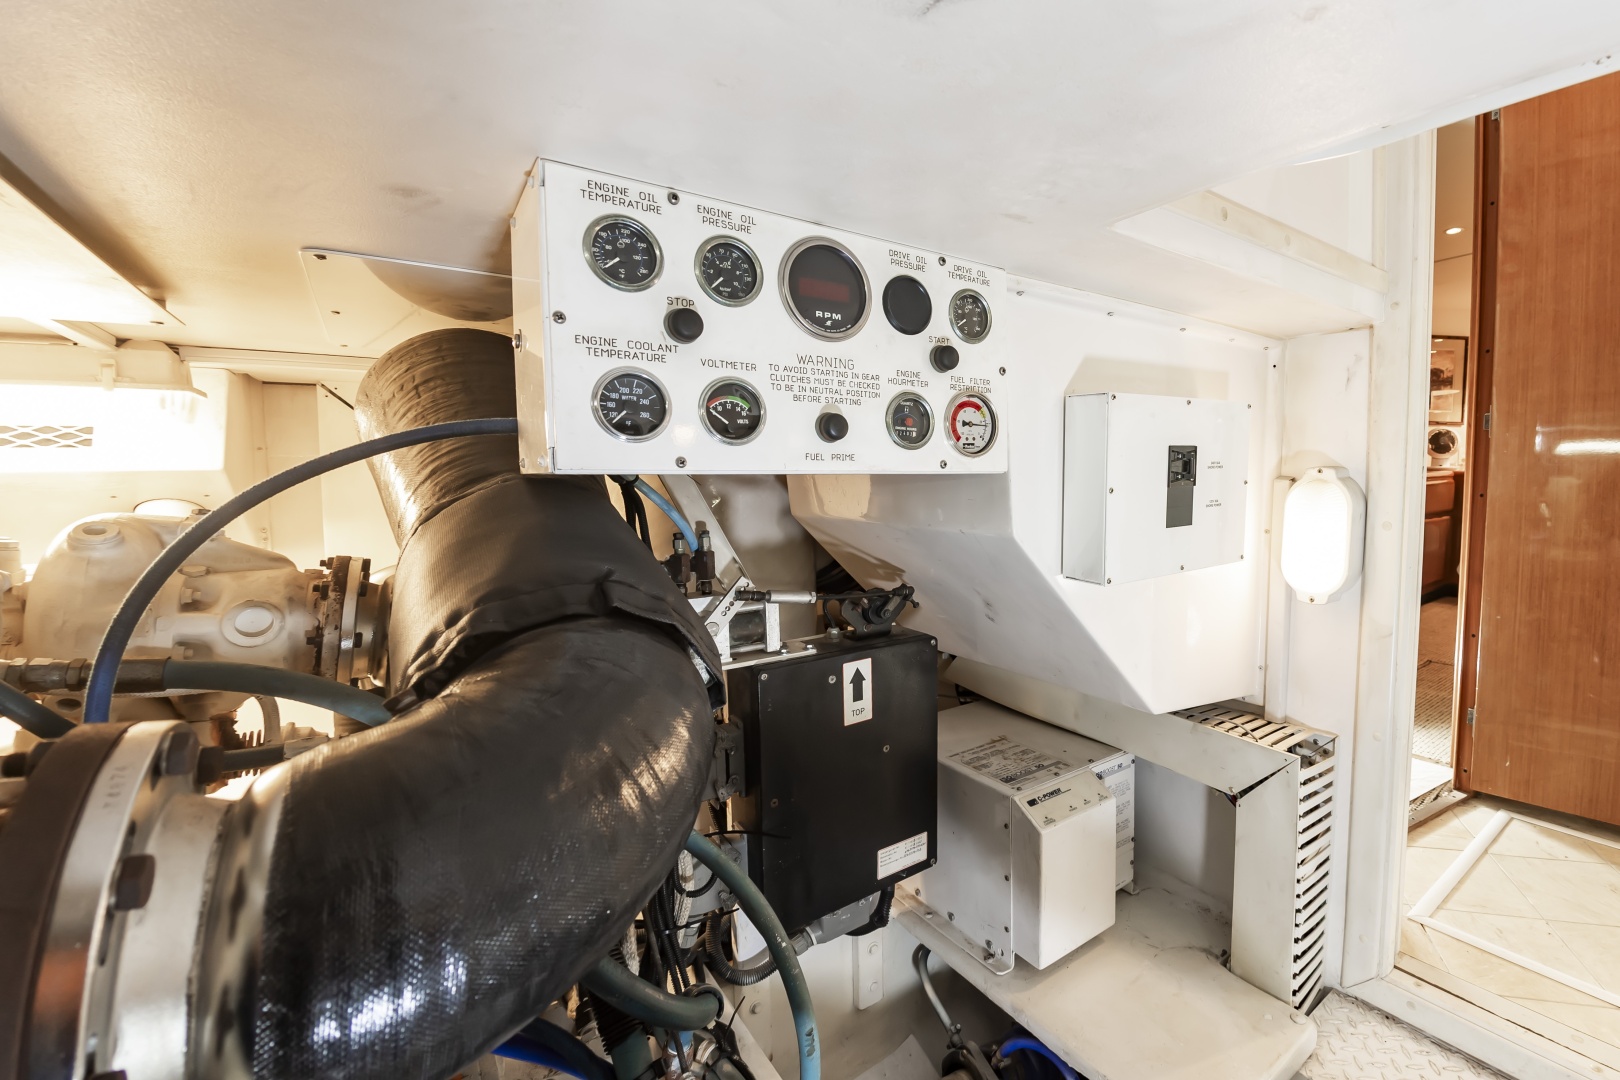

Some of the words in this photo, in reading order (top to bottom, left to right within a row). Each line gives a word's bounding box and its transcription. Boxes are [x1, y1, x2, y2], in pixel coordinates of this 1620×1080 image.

[588, 180, 629, 197] ENGINE
[639, 192, 658, 203] OIL
[580, 189, 662, 215] TEMPERATURE
[697, 205, 733, 221] ENGINE
[740, 214, 757, 225] OIL
[702, 216, 752, 234] PRESSURE
[889, 249, 910, 261] DRIVE
[916, 256, 927, 265] OIL
[891, 258, 926, 273] PRESSURE
[954, 264, 973, 274] DRIVE
[977, 270, 988, 278] OIL
[948, 271, 990, 287] TEMPERATURE
[667, 297, 695, 307] STOP
[816, 311, 842, 321] RPM
[575, 334, 618, 348] ENGINE
[627, 340, 679, 354] COOLANT
[928, 336, 950, 345] START
[586, 347, 667, 363] TEMPERATURE
[796, 353, 855, 371] WARNING
[700, 359, 757, 372] VOLTMETER
[769, 364, 780, 372] TO
[783, 365, 808, 375] AVOID
[811, 368, 849, 379] STARTING
[851, 372, 860, 380] IN
[862, 373, 880, 382] GEAR
[896, 370, 921, 379] ENGINE
[770, 374, 811, 384] CLUTCHES
[814, 378, 835, 387] MUST
[838, 380, 847, 388] BE
[849, 381, 881, 391] CHECKED
[888, 378, 929, 388] HOURMETER
[951, 376, 966, 384] FUEL
[970, 378, 991, 386] FILTER
[771, 383, 782, 391] TO
[785, 384, 795, 392] BE
[798, 385, 807, 393] IN
[810, 386, 844, 396] NEUTRAL
[846, 389, 881, 399] POSITION
[950, 384, 992, 394] RESTRICTION
[793, 394, 822, 404] BEFORE
[825, 397, 862, 406] STARTING
[805, 453, 825, 461] FUEL
[831, 454, 855, 462] PRIME
[851, 708, 866, 717] TOP
[1038, 788, 1063, 801] C-POWER
